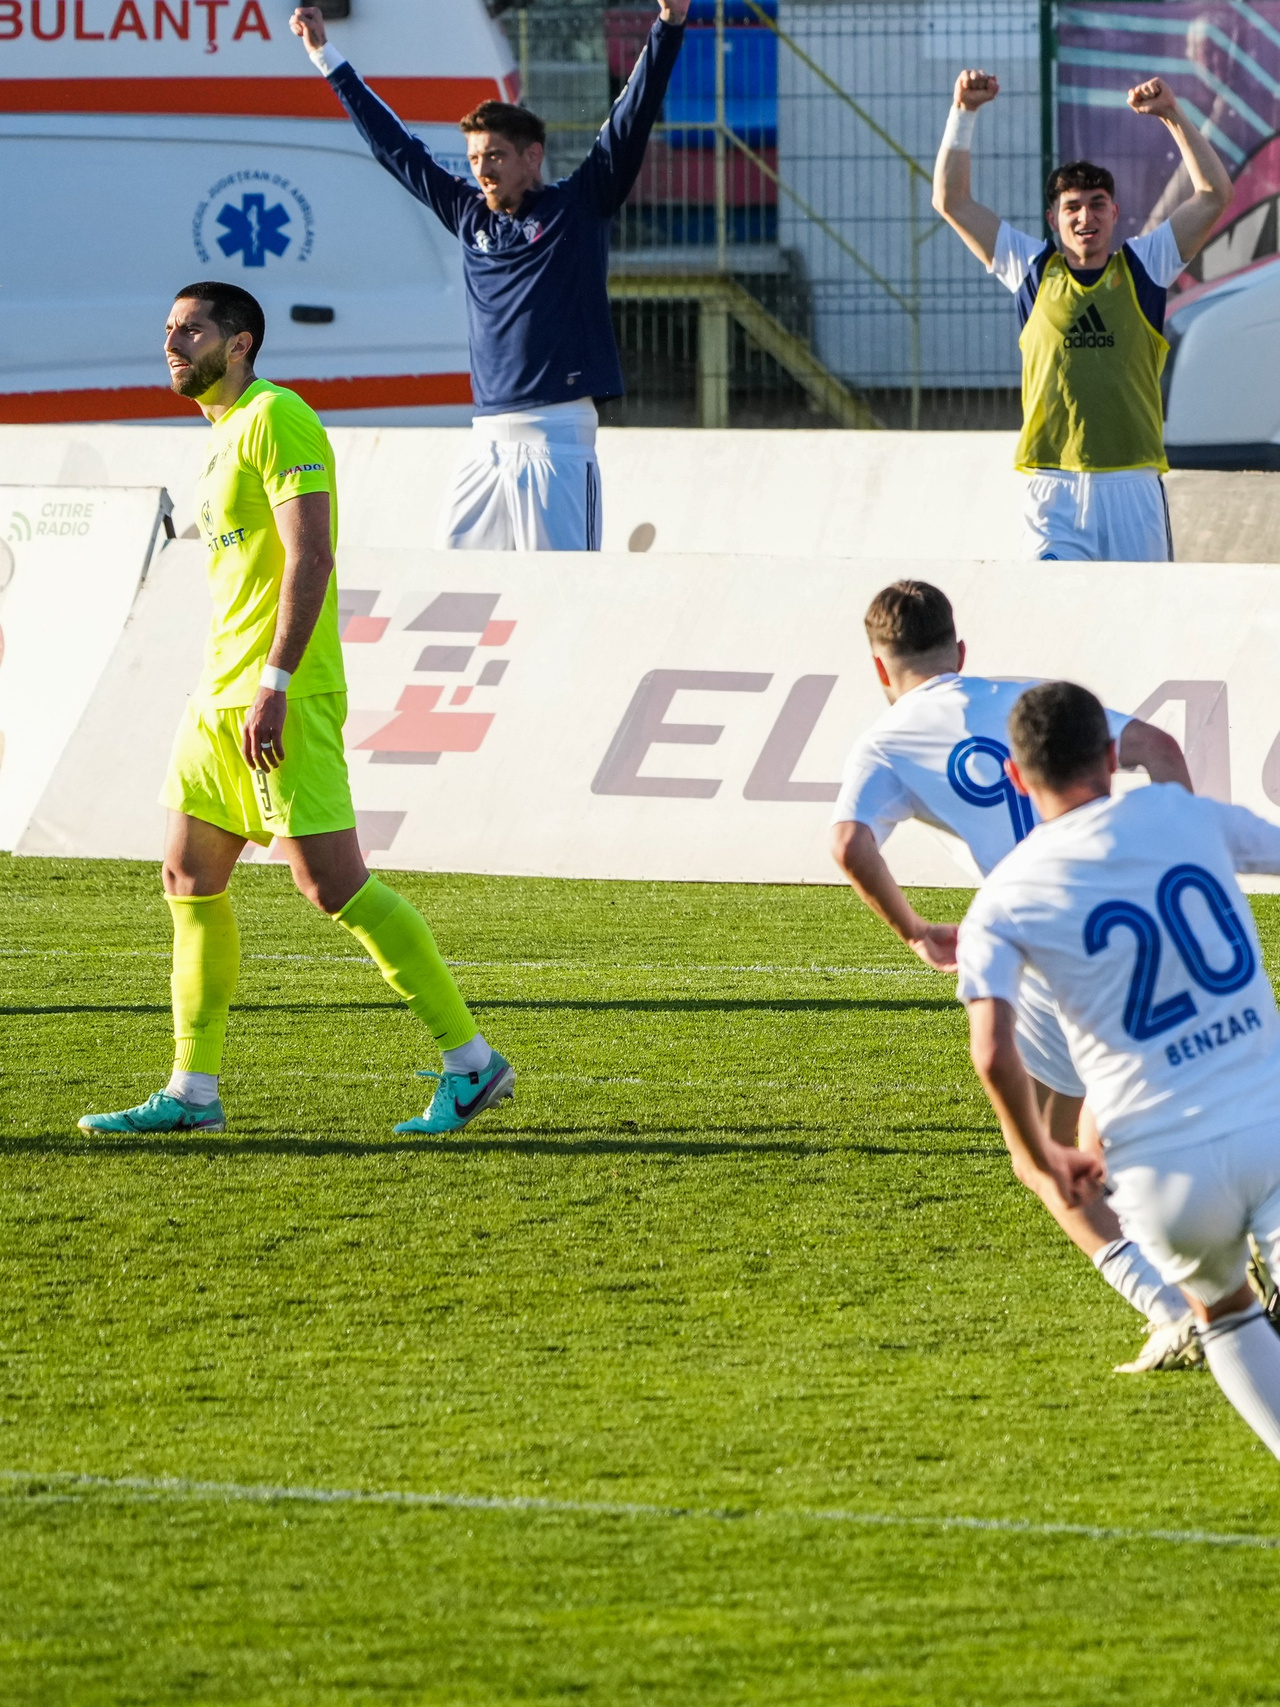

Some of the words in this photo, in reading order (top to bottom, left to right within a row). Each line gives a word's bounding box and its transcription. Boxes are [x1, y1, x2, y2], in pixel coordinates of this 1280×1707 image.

[1063, 331, 1115, 349] adidas
[35, 521, 90, 536] RADIO
[41, 502, 94, 518] CITIRE
[946, 735, 1036, 846] 9
[1083, 863, 1256, 1042] 20
[1164, 1006, 1262, 1067] BENZAR
